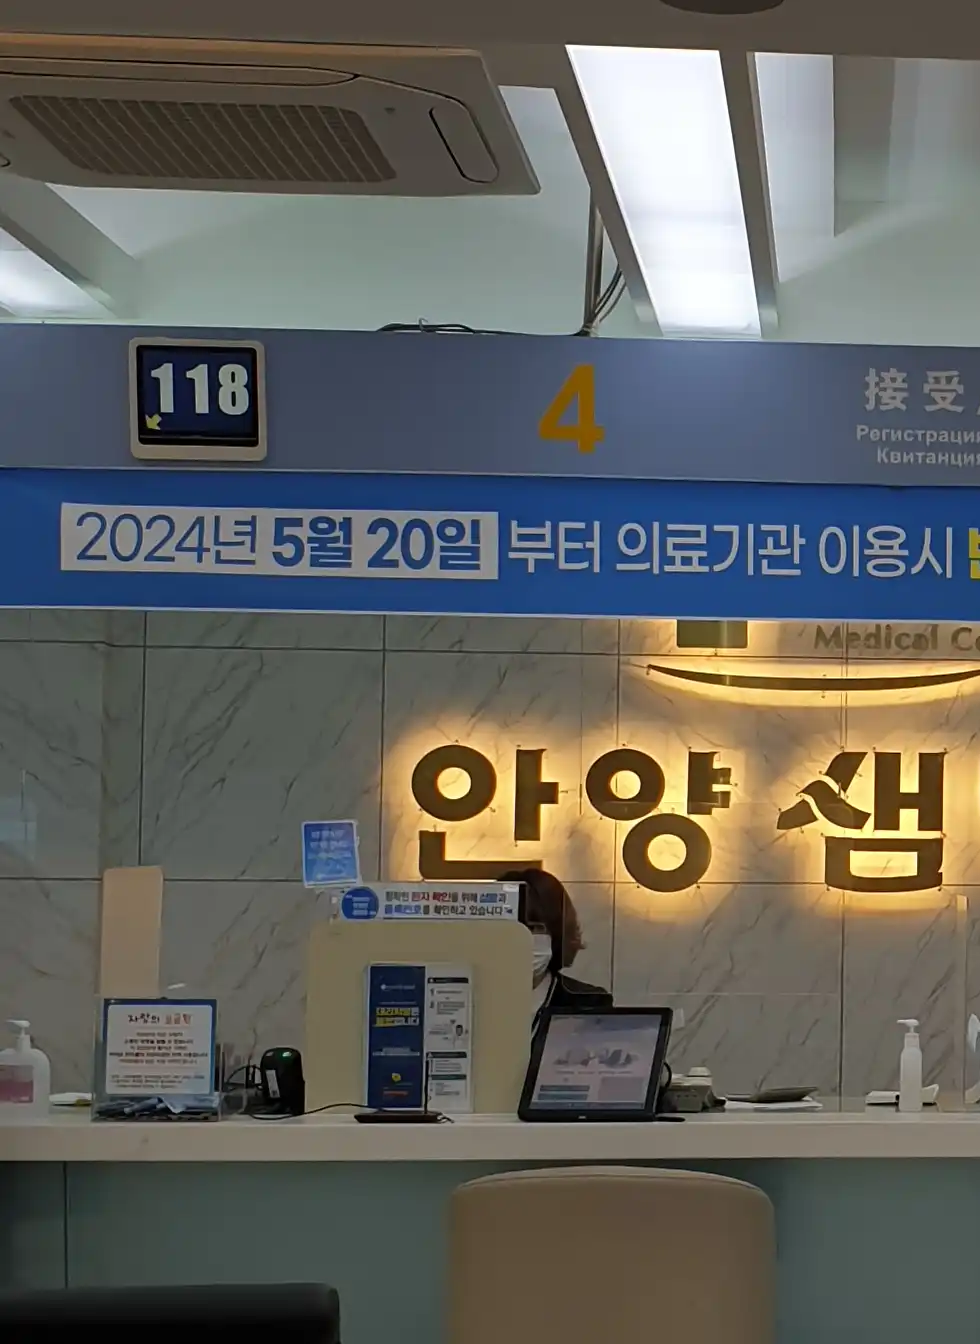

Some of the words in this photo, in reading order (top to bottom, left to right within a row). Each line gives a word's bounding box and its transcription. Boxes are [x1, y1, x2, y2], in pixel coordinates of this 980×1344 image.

[150, 361, 251, 417] 118
[537, 363, 606, 454] 4
[75, 511, 257, 566] 2024년
[271, 516, 354, 569] 5월
[366, 518, 482, 571] 20일
[507, 519, 601, 574] 부터
[615, 521, 802, 576] 의료기관
[818, 524, 953, 579] 이용시
[813, 623, 940, 652] Medical
[411, 744, 732, 894] 안양
